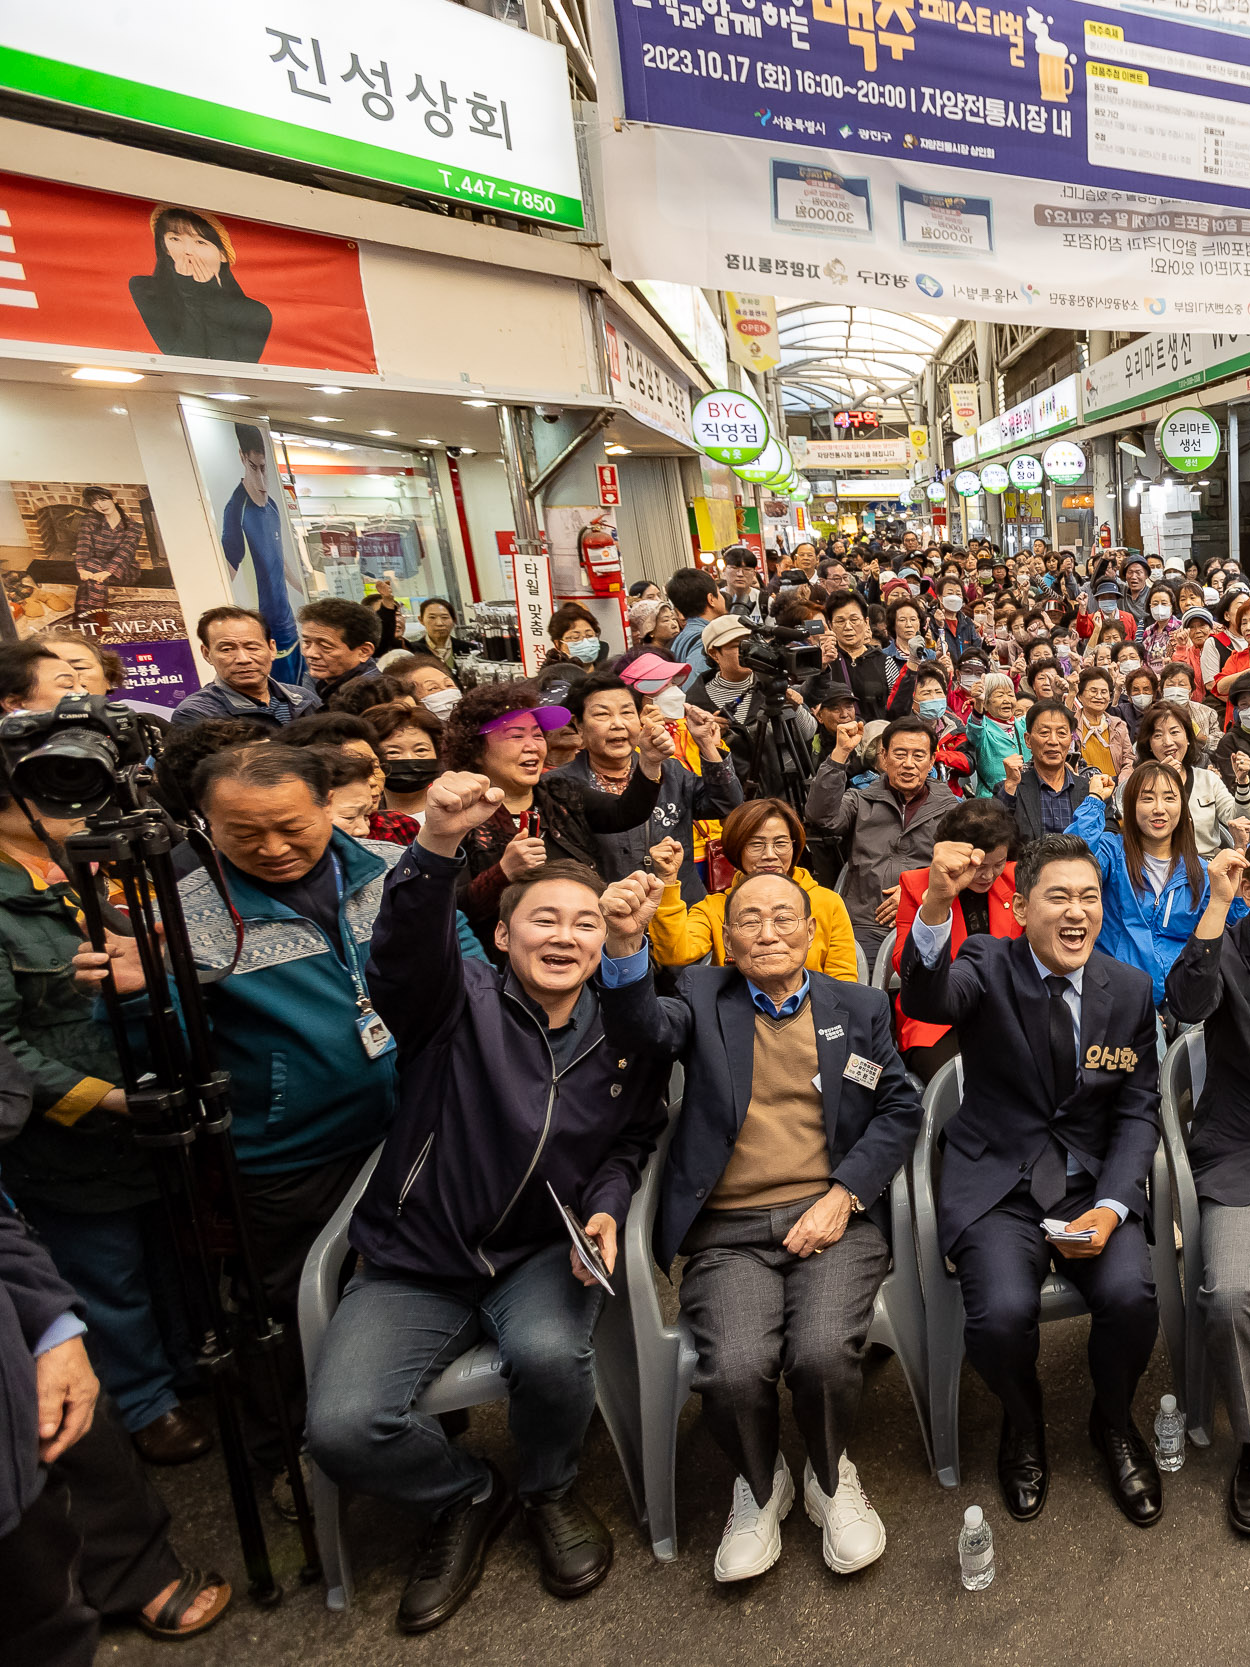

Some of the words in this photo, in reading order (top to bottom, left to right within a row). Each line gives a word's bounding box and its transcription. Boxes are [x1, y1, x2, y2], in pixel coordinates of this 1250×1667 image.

[919, 0, 1025, 68] 페스티벌
[265, 27, 513, 150] 진성상회
[643, 43, 750, 83] 2023.10.17
[756, 61, 791, 92] (화)
[795, 69, 906, 110] 16:00~20:00
[920, 86, 1048, 134] 자양전통시장
[1052, 107, 1072, 138] 내
[772, 115, 826, 135] 서울특별시
[439, 168, 557, 217] T.447-7850
[740, 324, 767, 333] OPEN
[708, 402, 747, 419] BYC
[701, 423, 758, 443] 직영점
[1168, 423, 1211, 436] 우리마트
[1180, 439, 1201, 452] 생선
[1017, 471, 1035, 480] 장어
[524, 563, 539, 596] 타월
[113, 618, 178, 634] WEAR
[528, 604, 543, 637] 맞춤
[123, 664, 160, 677] 크퐁을
[1085, 1045, 1138, 1072] 오신환
